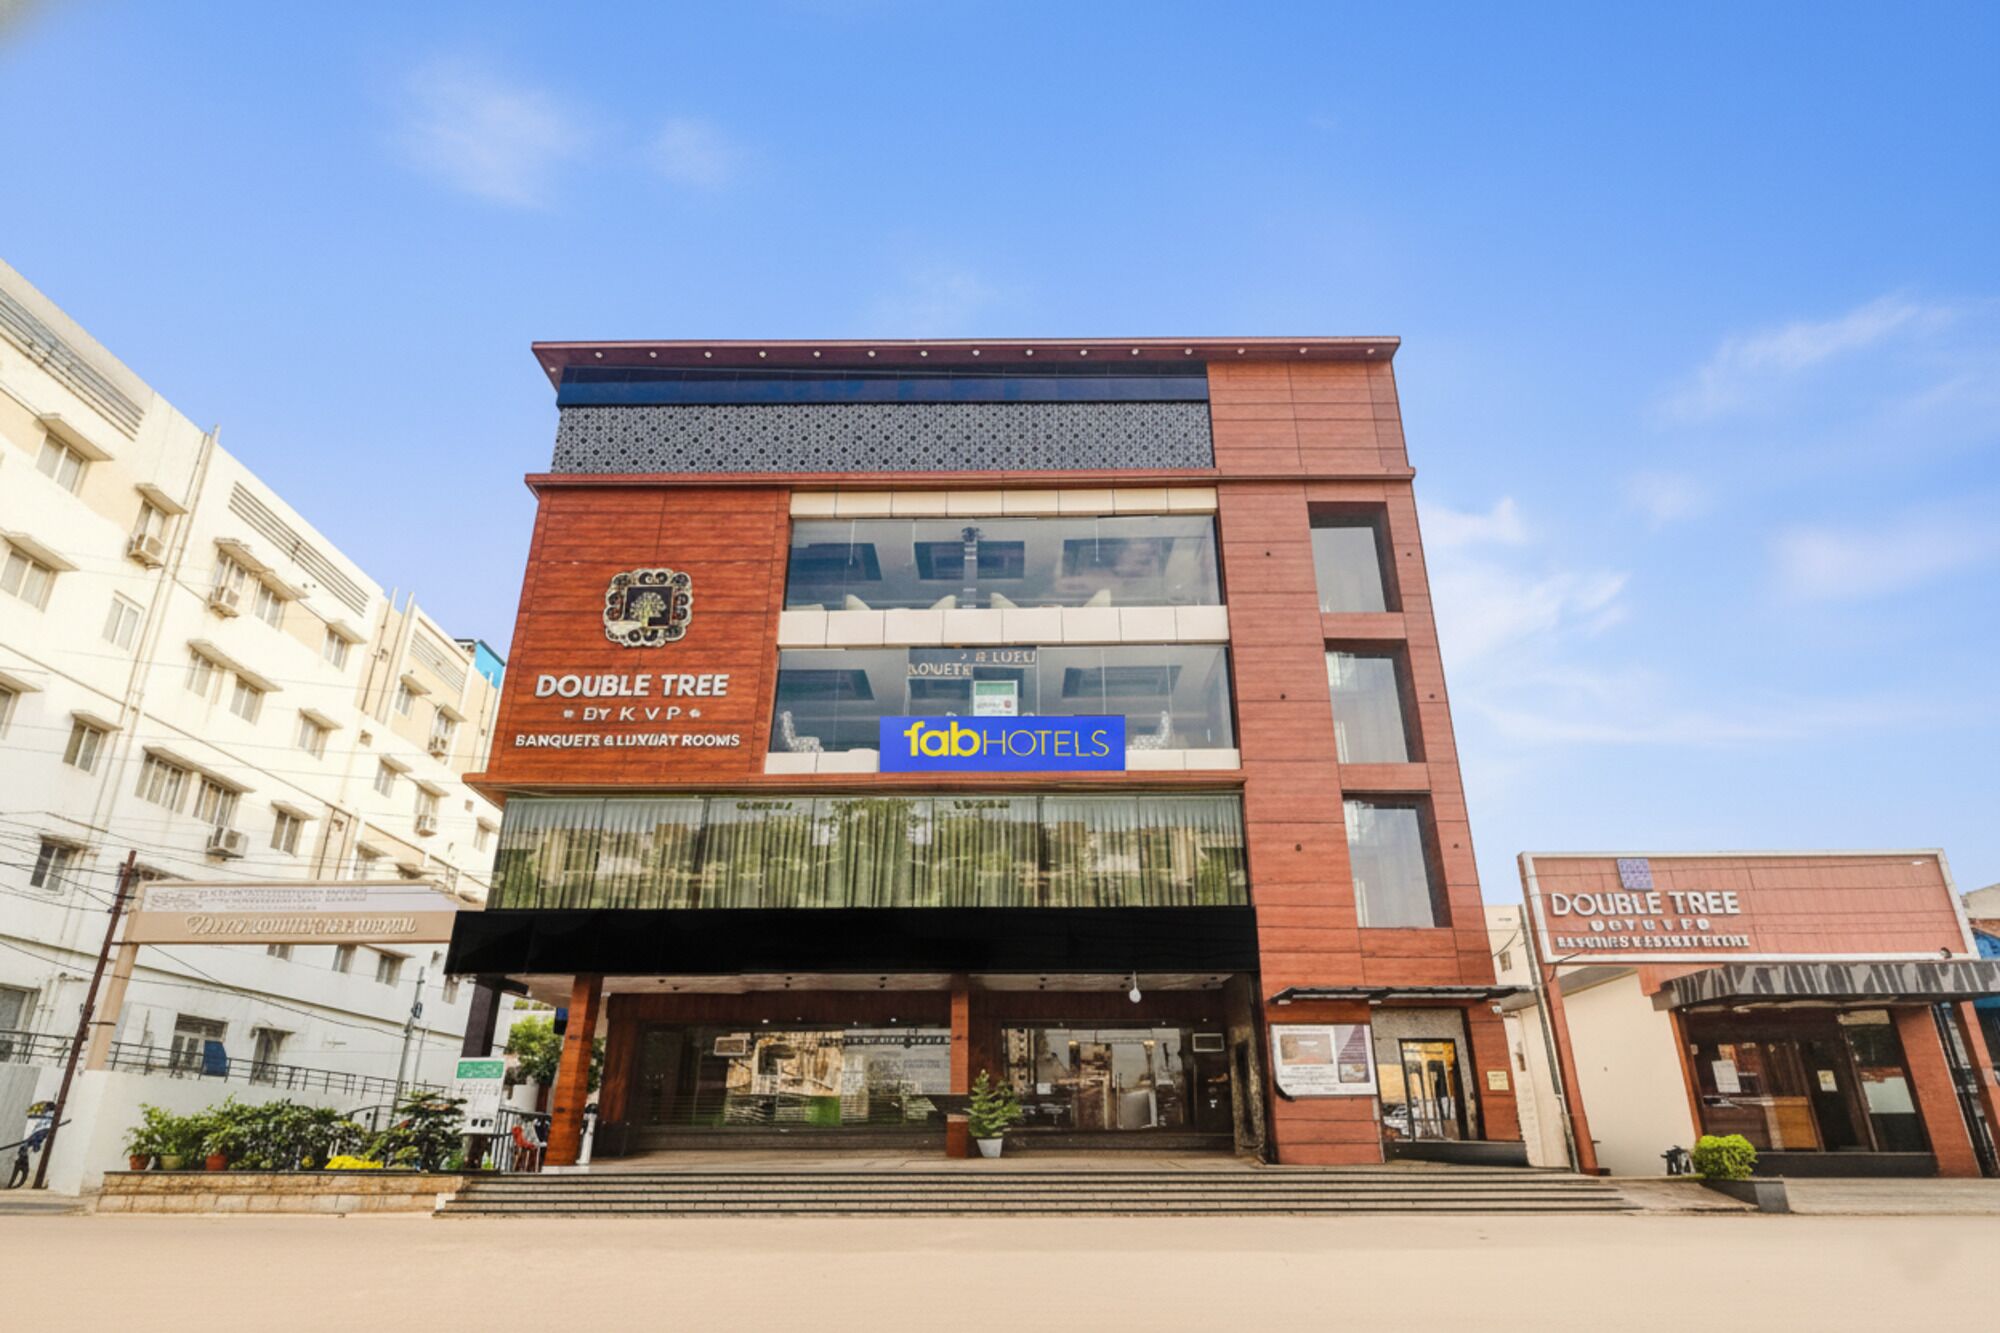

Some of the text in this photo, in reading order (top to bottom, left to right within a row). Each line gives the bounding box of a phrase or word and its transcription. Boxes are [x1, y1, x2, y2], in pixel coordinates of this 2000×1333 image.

[535, 674, 730, 697] DOUBLE TREE
[681, 734, 741, 746] ROOMS
[1551, 891, 1741, 916] DOUBLE TREE
